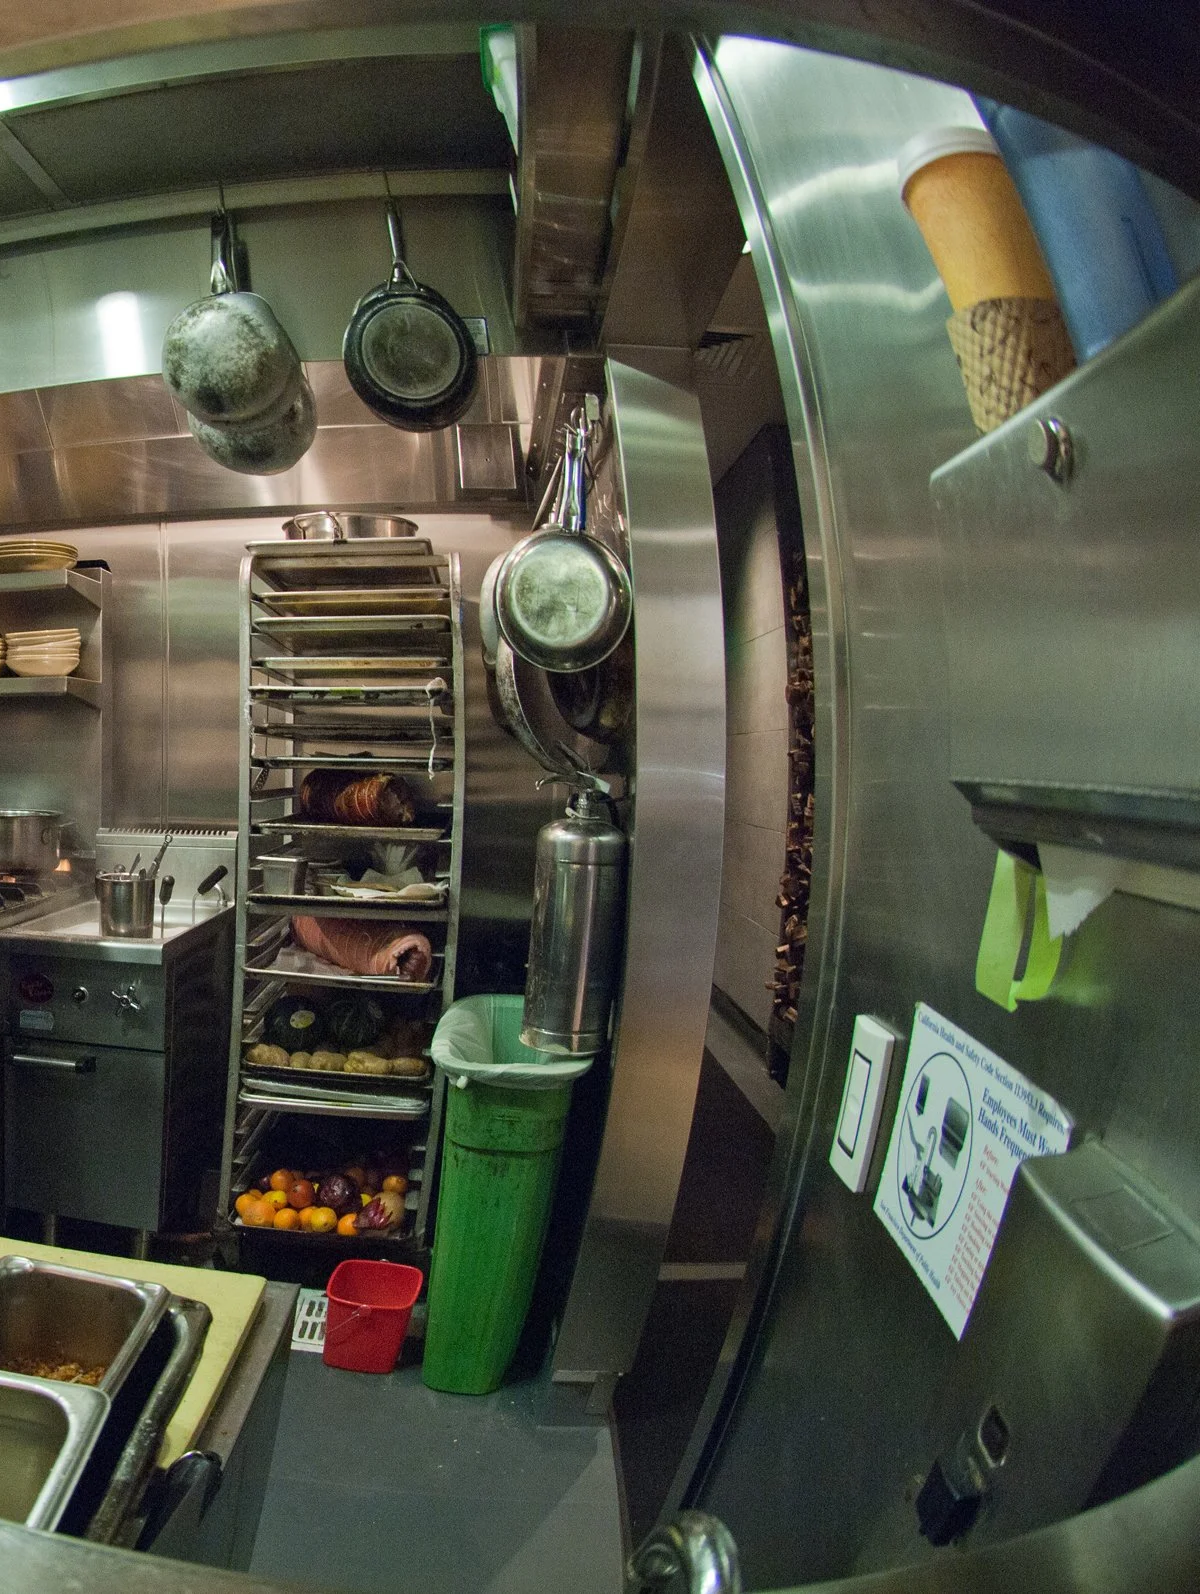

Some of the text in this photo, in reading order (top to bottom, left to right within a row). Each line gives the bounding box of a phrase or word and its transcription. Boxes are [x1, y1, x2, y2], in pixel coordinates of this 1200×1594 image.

[918, 1012, 939, 1034] California
[940, 1027, 955, 1046] Health
[955, 1042, 965, 1054] and
[966, 1045, 980, 1066] Safety
[981, 1058, 994, 1076] Code
[995, 1068, 1013, 1091] Section
[978, 1107, 998, 1137] Hands
[982, 1088, 1017, 1129] Employees
[1020, 1118, 1037, 1147] Must
